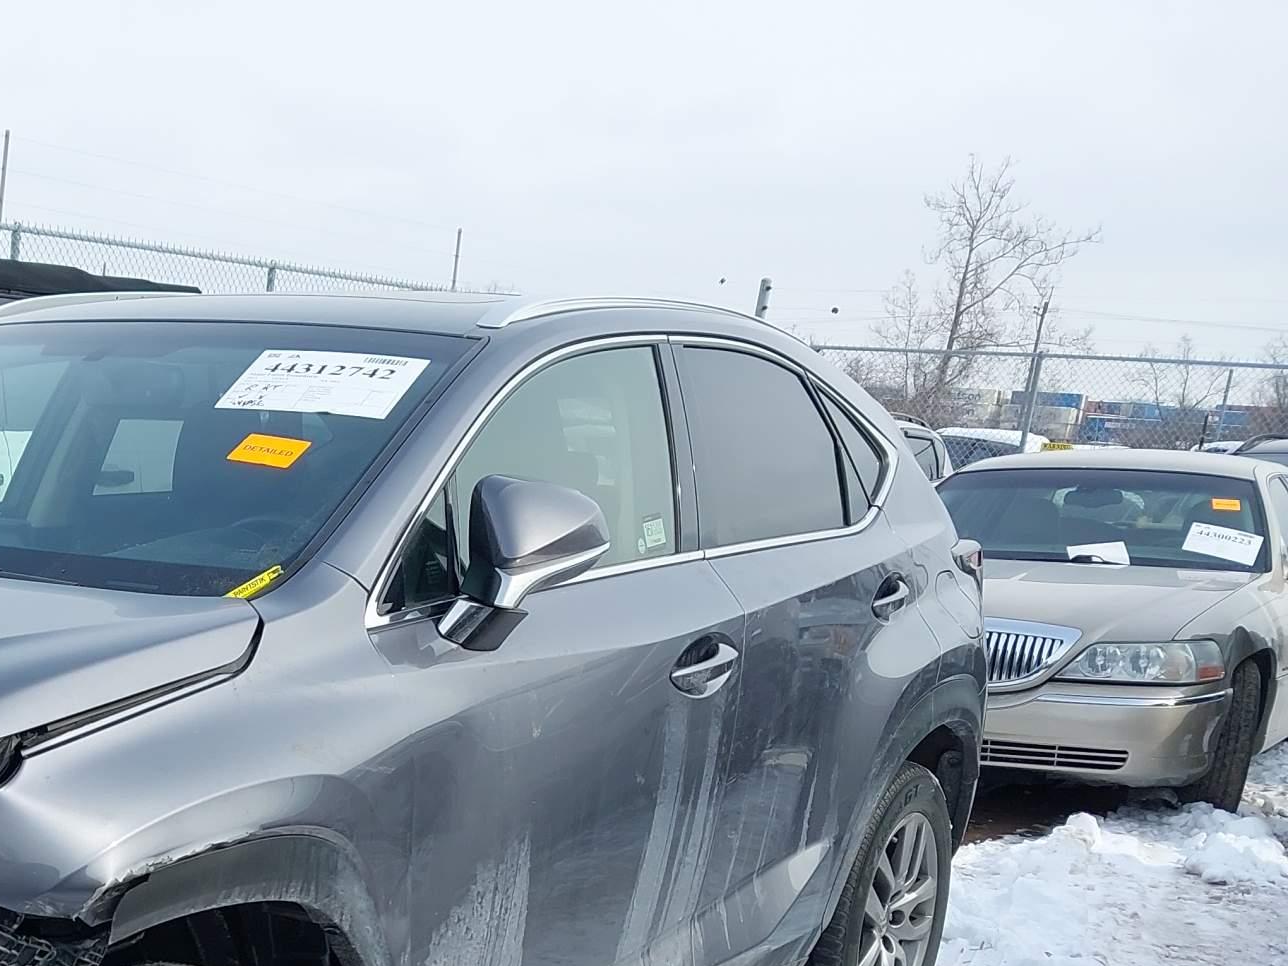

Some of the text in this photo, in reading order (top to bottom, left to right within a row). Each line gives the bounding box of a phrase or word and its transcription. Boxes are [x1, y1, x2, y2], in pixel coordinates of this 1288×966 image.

[264, 362, 396, 380] 44312742
[242, 444, 294, 457] DETAILED
[1196, 530, 1252, 546] 44300223
